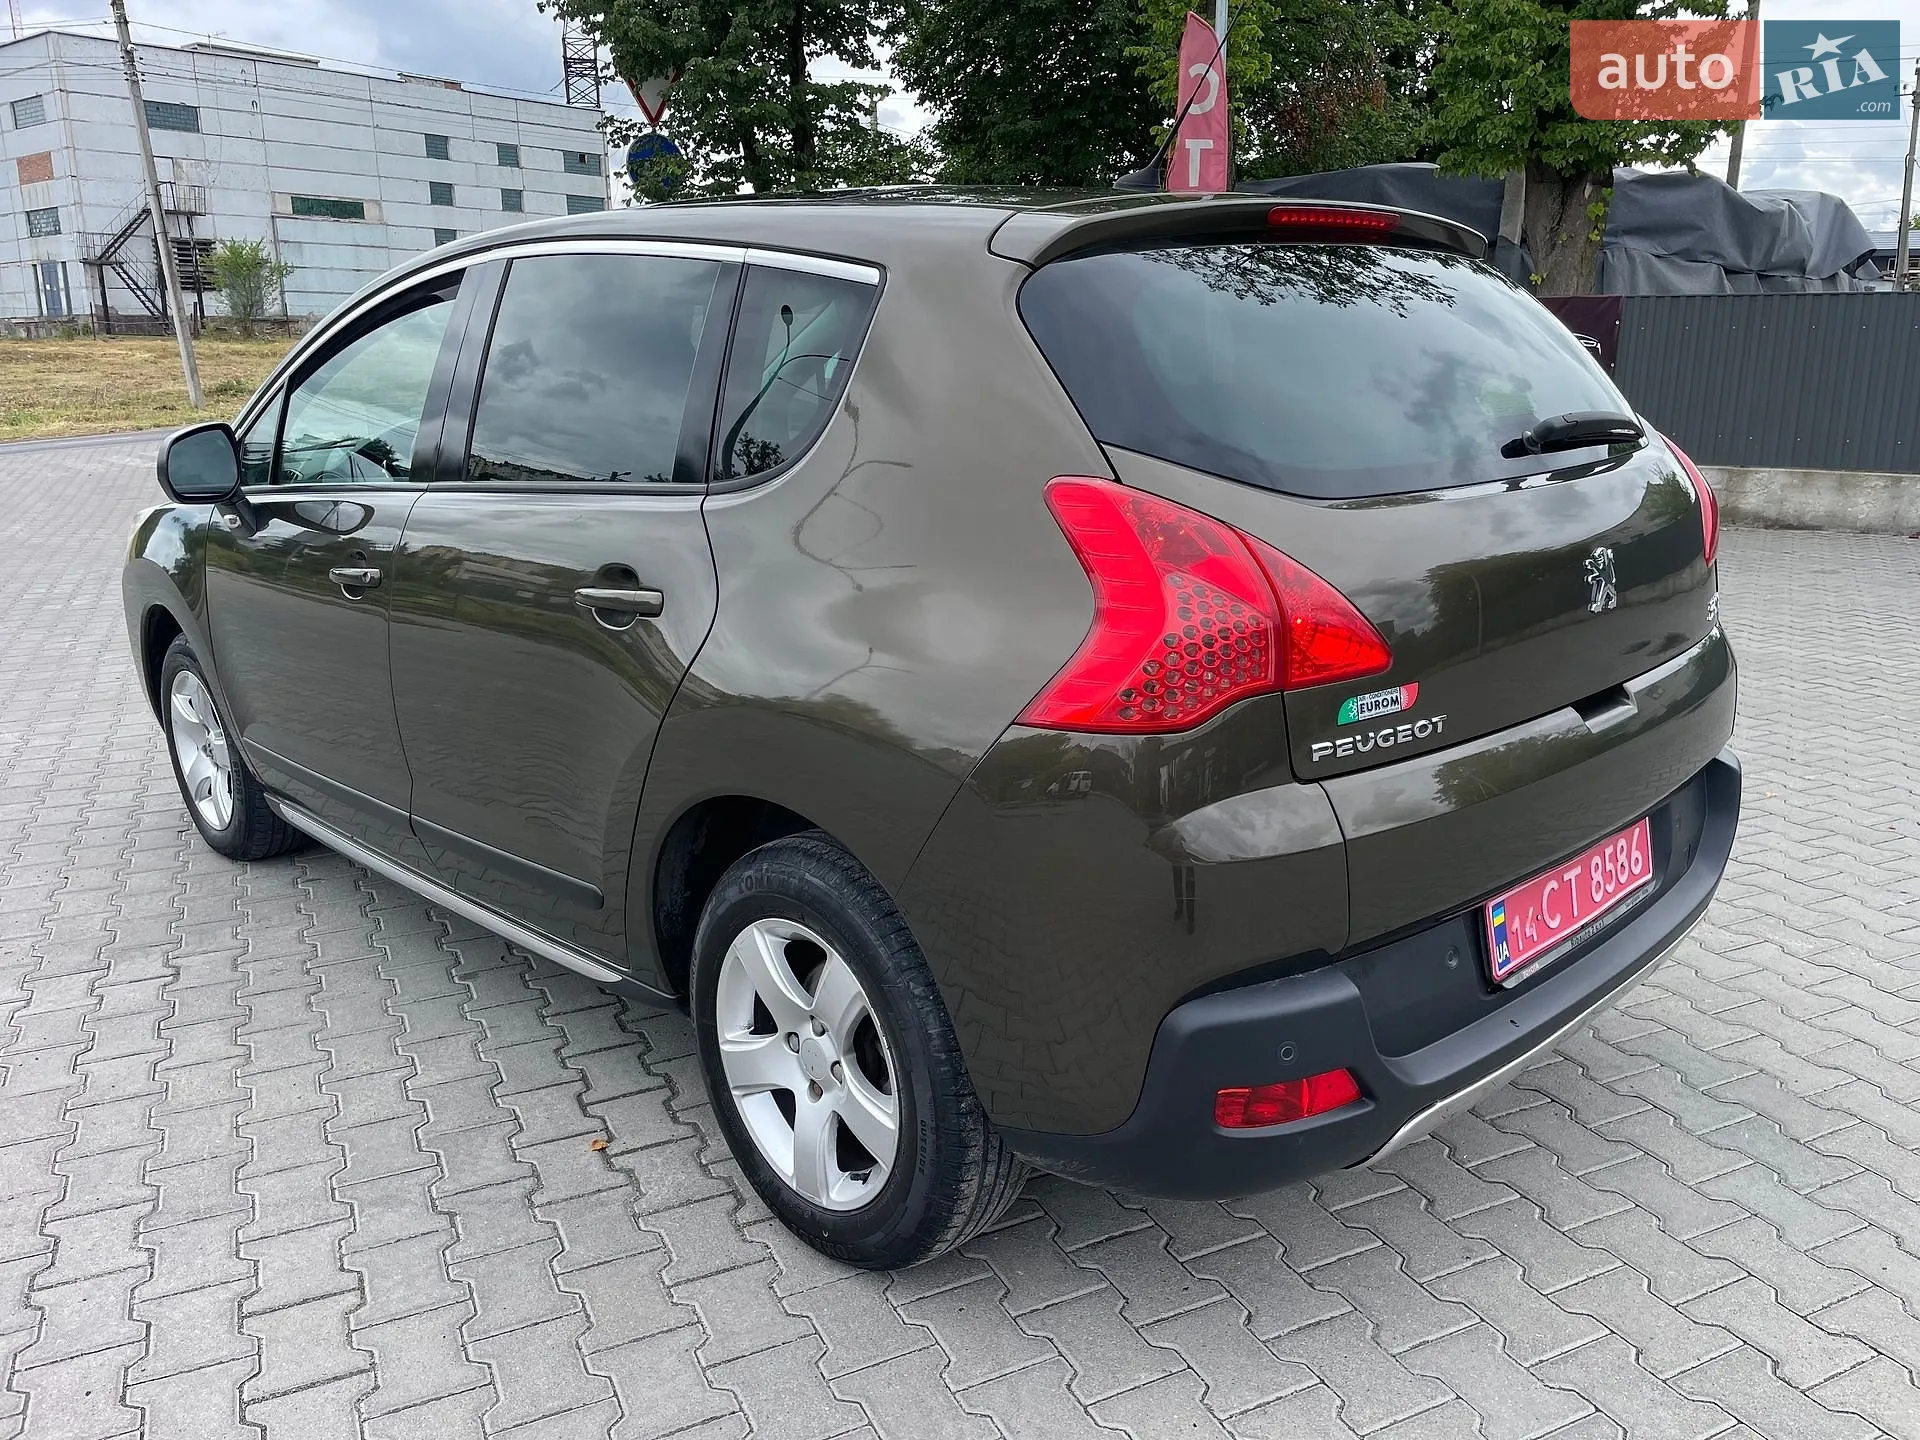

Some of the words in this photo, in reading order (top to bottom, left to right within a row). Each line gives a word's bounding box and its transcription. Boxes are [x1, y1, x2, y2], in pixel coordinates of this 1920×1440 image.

[1359, 695, 1400, 715] EUROM
[1311, 714, 1448, 762] PEUGEOT
[1590, 827, 1643, 903] 8586
[1496, 940, 1510, 963] UA
